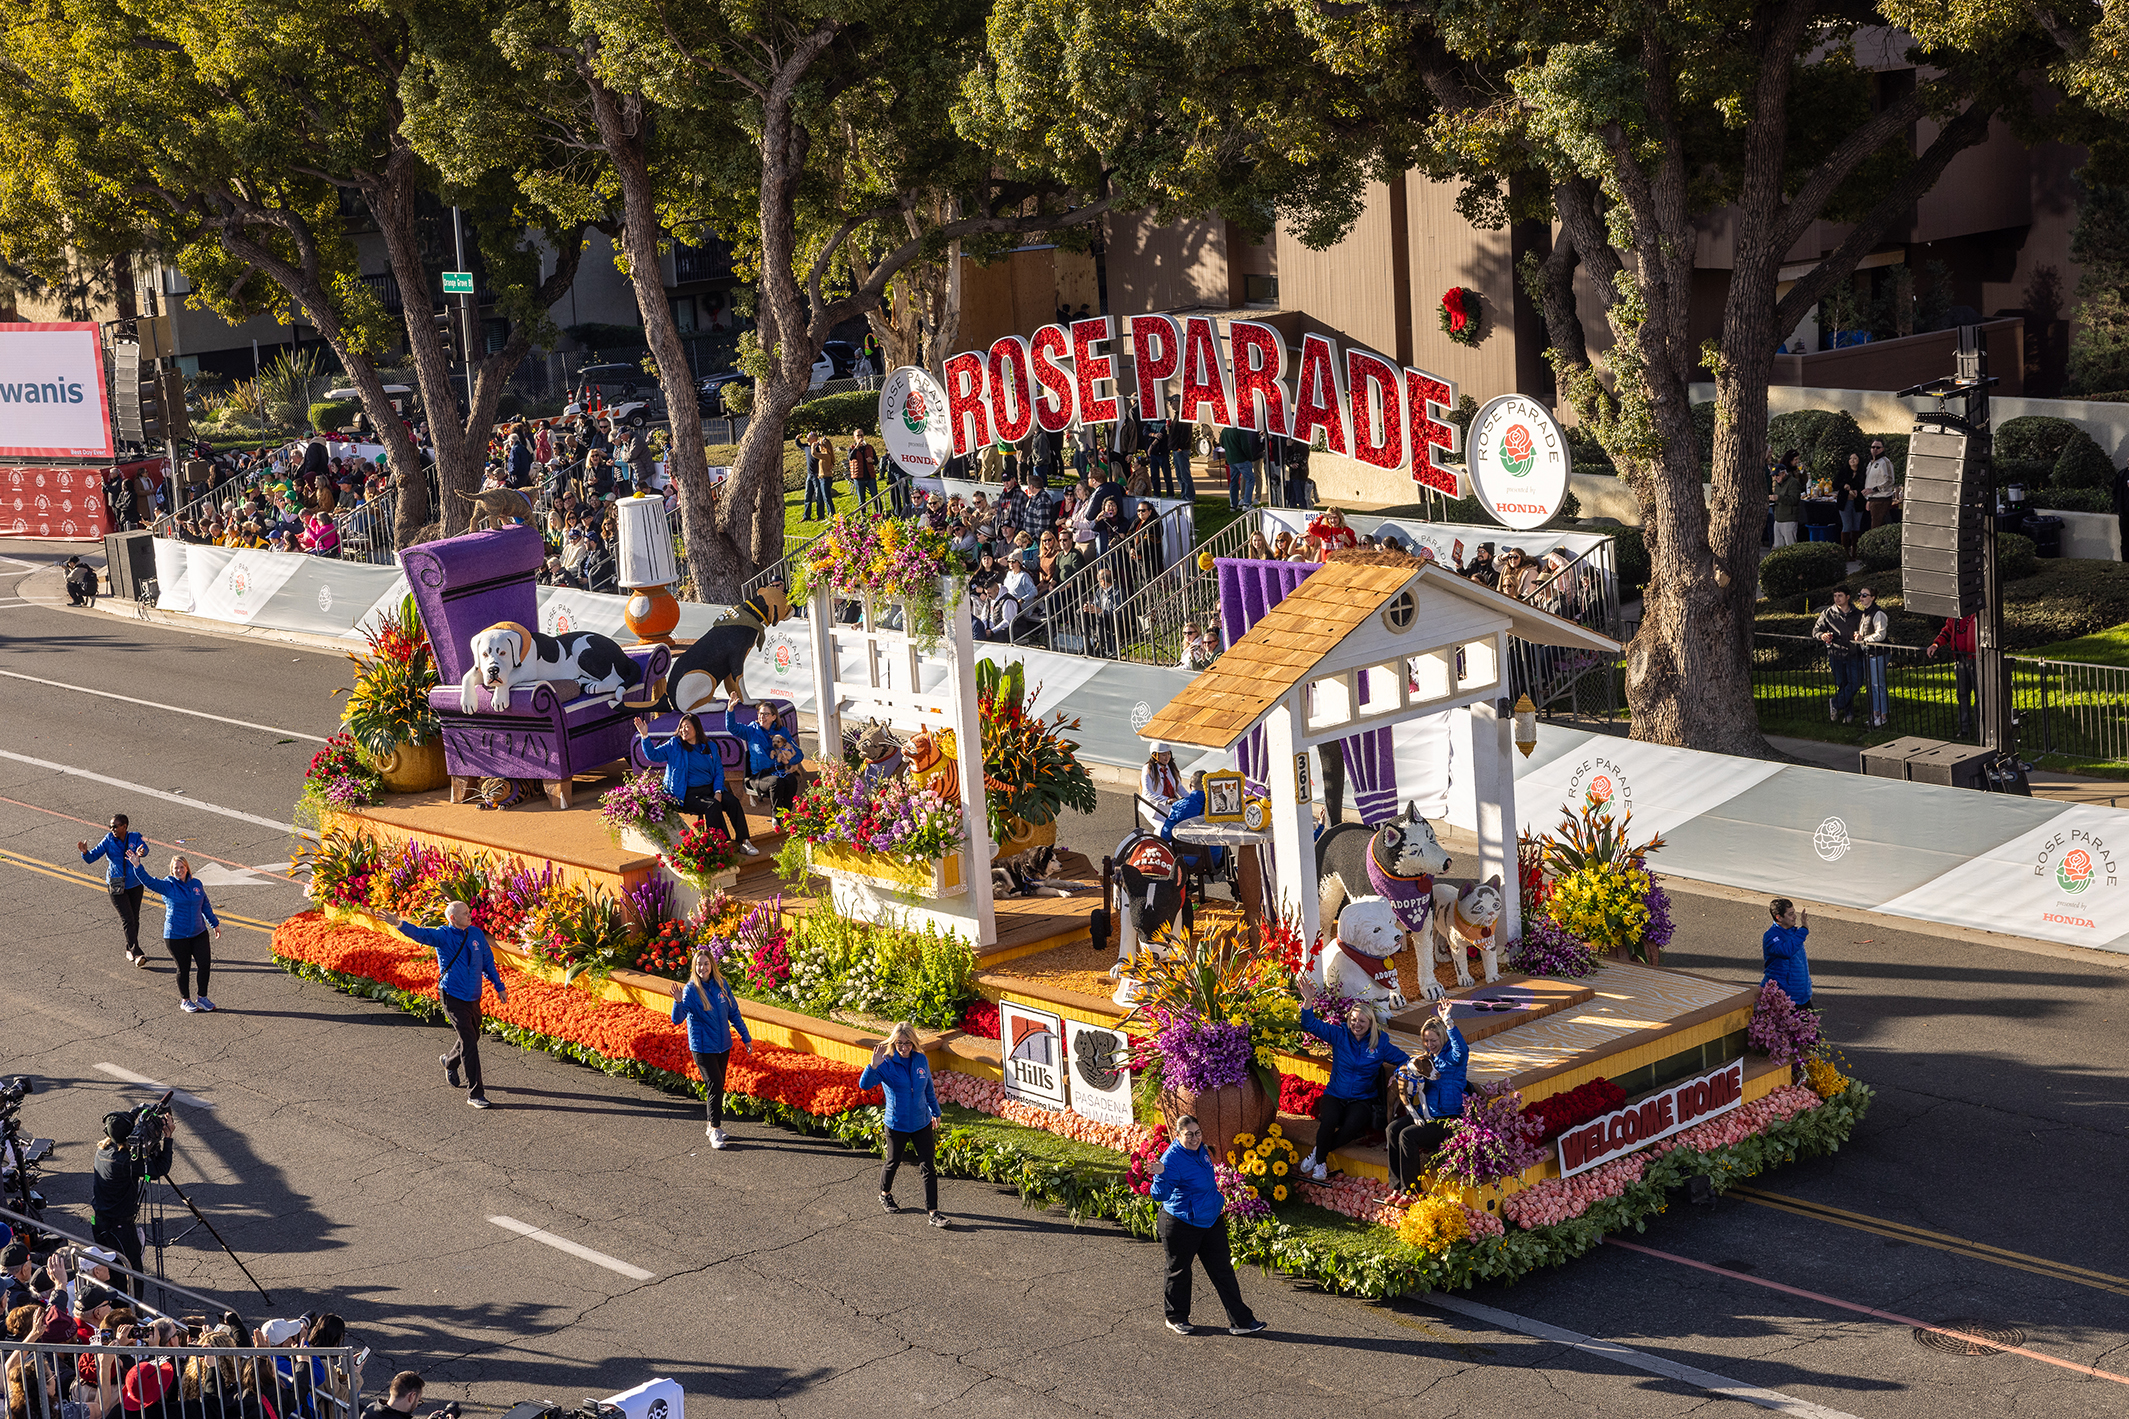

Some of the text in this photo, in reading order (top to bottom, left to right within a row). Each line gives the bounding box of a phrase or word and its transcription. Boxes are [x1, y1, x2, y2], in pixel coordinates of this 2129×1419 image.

[886, 372, 946, 424] ROSE PARADE
[943, 313, 1467, 501] ROSE PARADE
[1478, 401, 1559, 463] ROSE PARADE
[900, 454, 938, 466] HONDA
[1506, 486, 1536, 494] presented by
[1496, 503, 1548, 514] HONDA
[547, 603, 578, 634] ROSE PARAD
[764, 632, 803, 669] ROSE PARADE
[770, 688, 794, 698] HONDA
[1298, 755, 1308, 800] 361
[1568, 757, 1632, 808] ROSE PARADE
[2034, 829, 2117, 886] ROSE PARADE
[2042, 912, 2096, 928] HONDA
[2056, 900, 2087, 911] presented by
[1014, 1060, 1054, 1090] Hill's
[1075, 1091, 1129, 1115] PASADENA
[1561, 1065, 1742, 1171] WELCOME HOME
